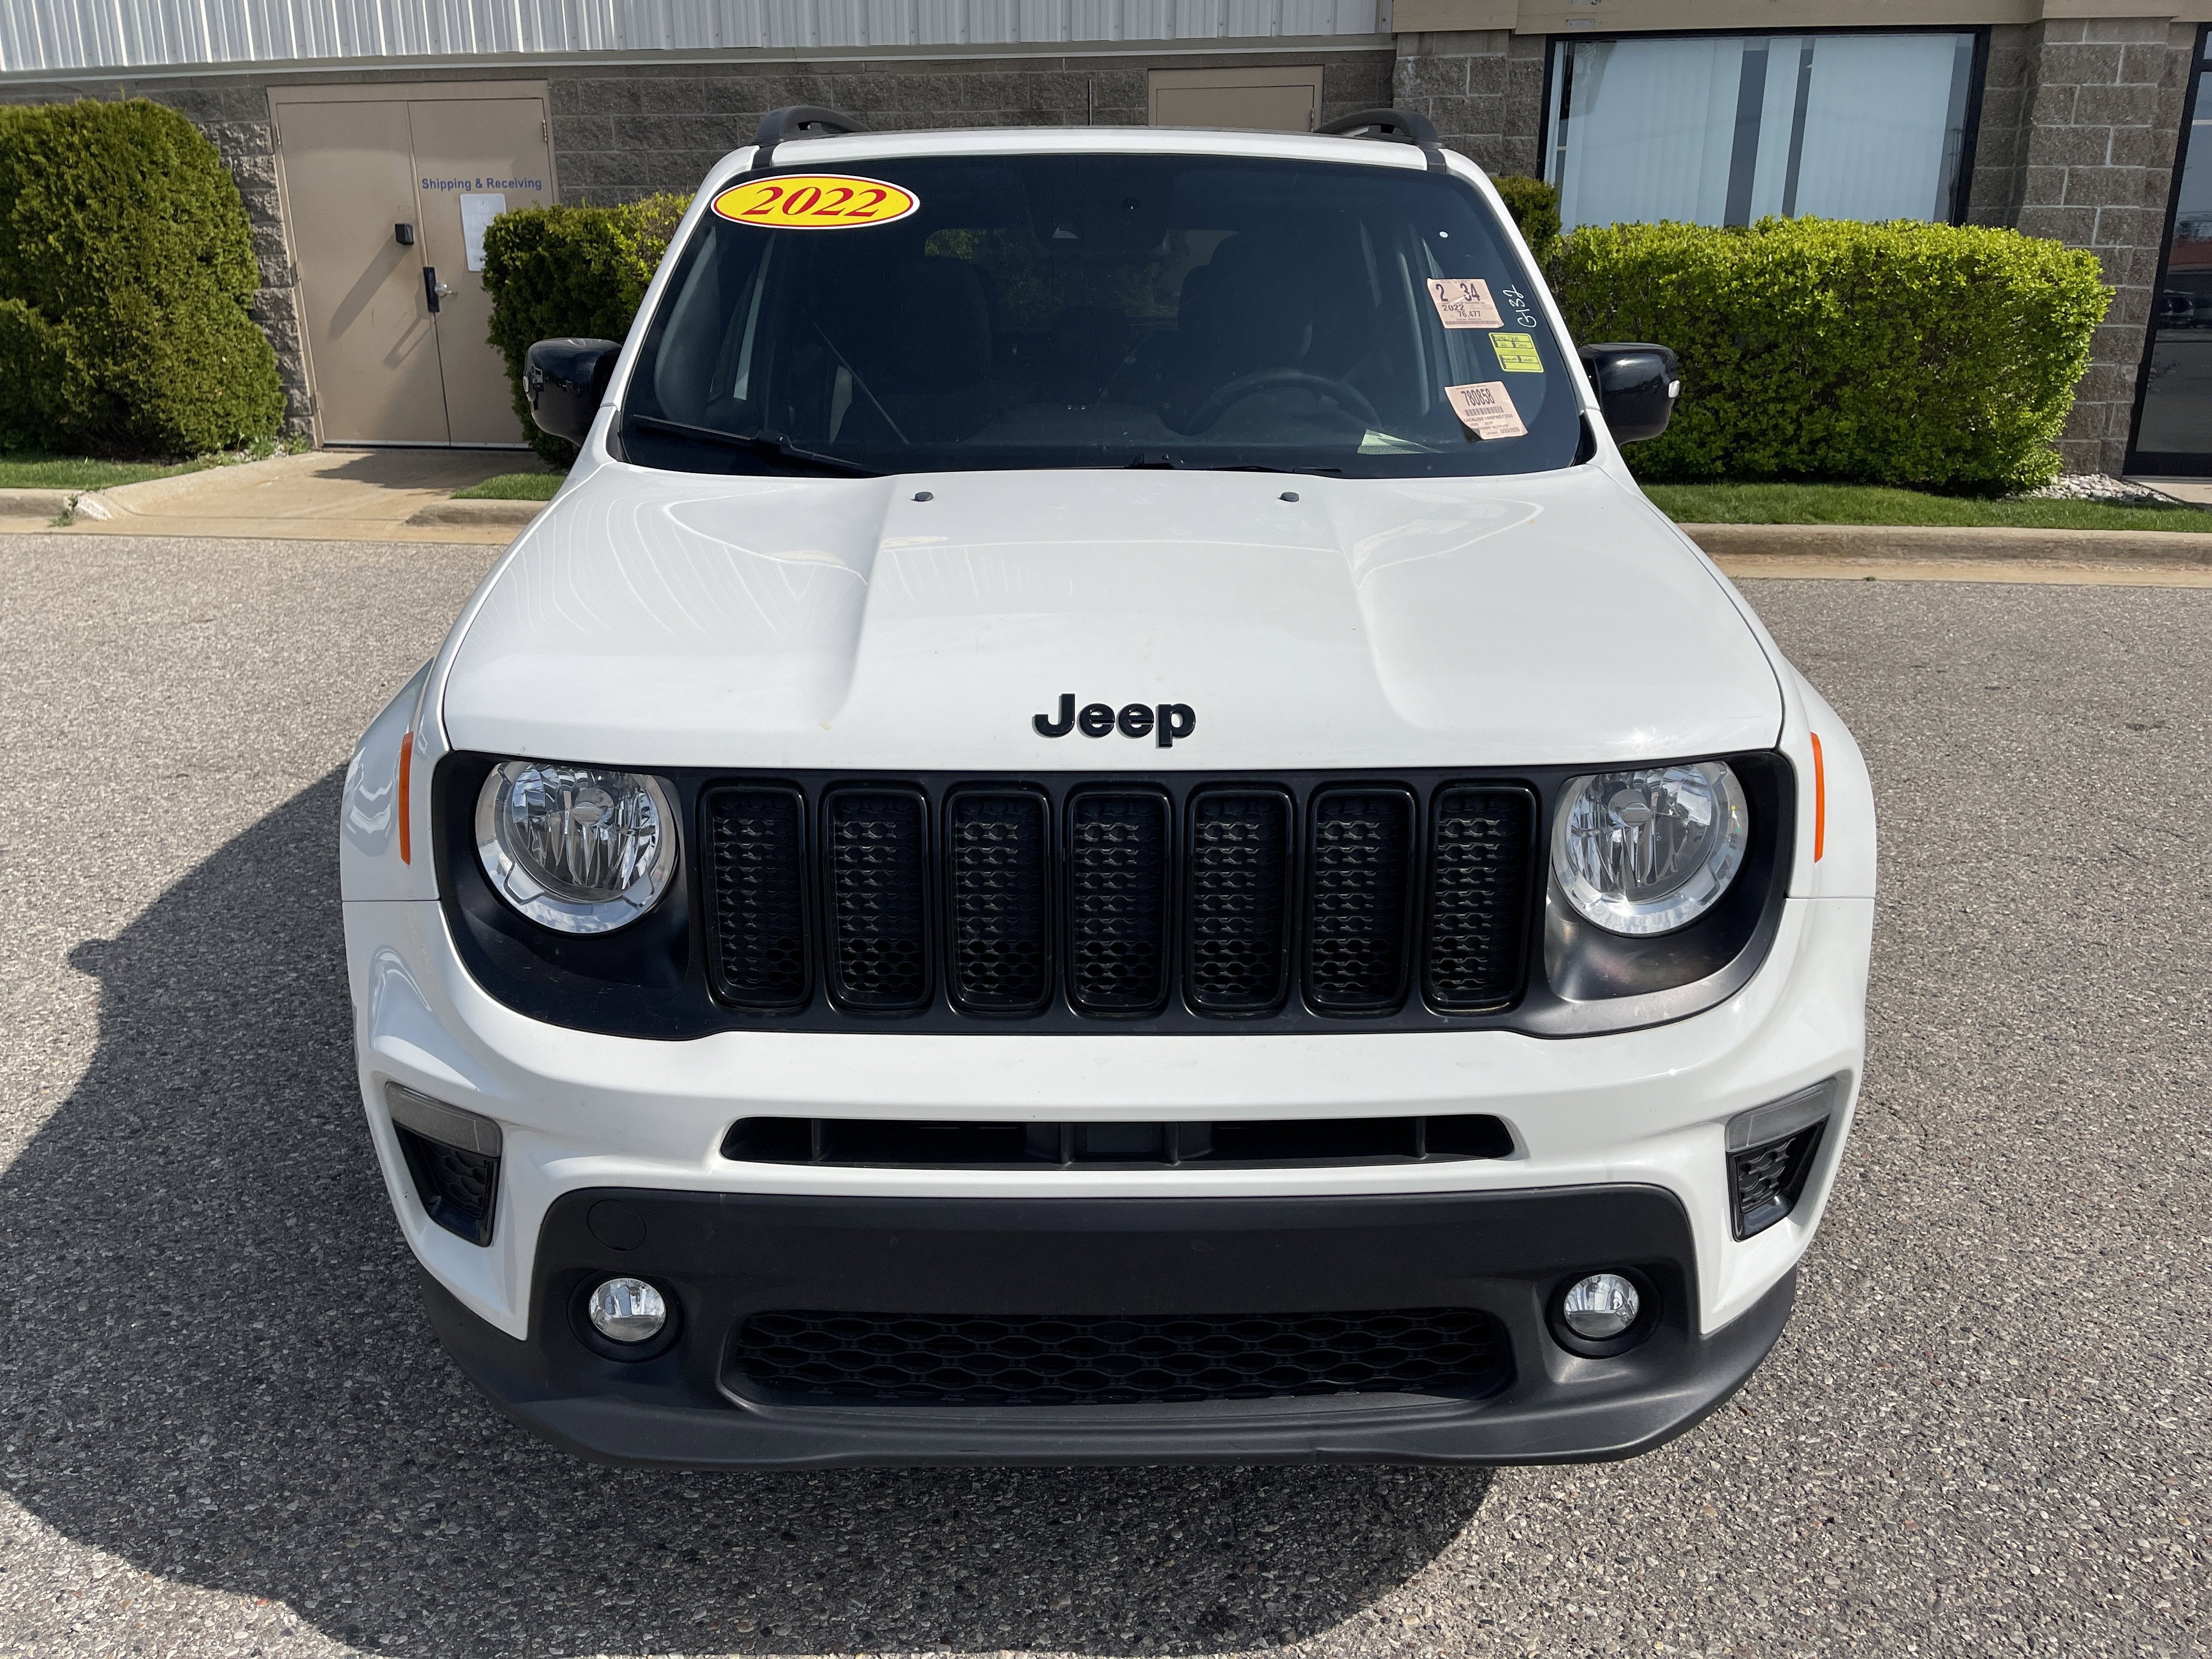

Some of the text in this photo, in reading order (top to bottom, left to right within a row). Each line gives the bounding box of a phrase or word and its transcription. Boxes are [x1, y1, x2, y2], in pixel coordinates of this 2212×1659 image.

[422, 177, 542, 191] Shipping & Receiving
[741, 187, 887, 217] 2022
[1436, 283, 1480, 302] 2 34
[1460, 388, 1495, 407] 780858
[1033, 693, 1195, 747] Jeep
